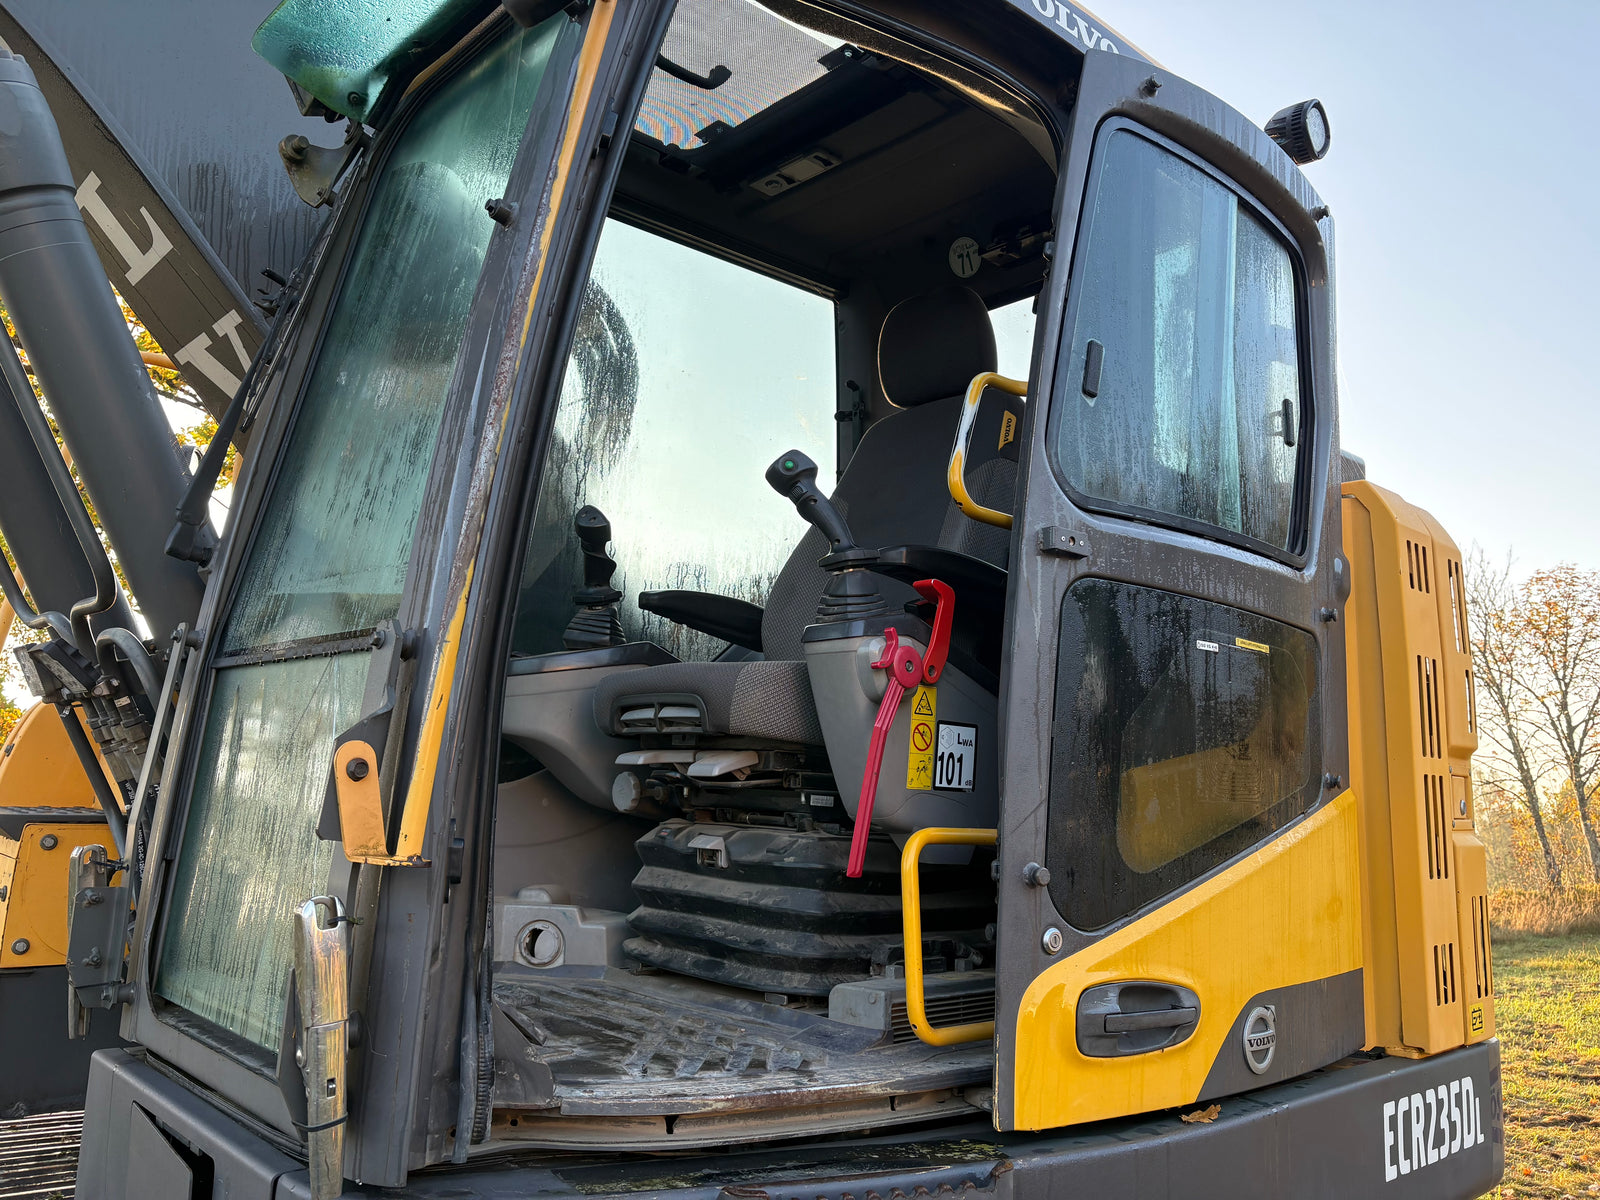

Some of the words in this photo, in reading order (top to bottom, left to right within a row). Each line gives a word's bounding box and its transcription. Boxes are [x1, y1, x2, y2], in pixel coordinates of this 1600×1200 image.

[957, 251, 973, 274] 71
[1004, 418, 1012, 442] VOLVO
[938, 751, 964, 786] 101
[1247, 1034, 1276, 1048] VOLVO
